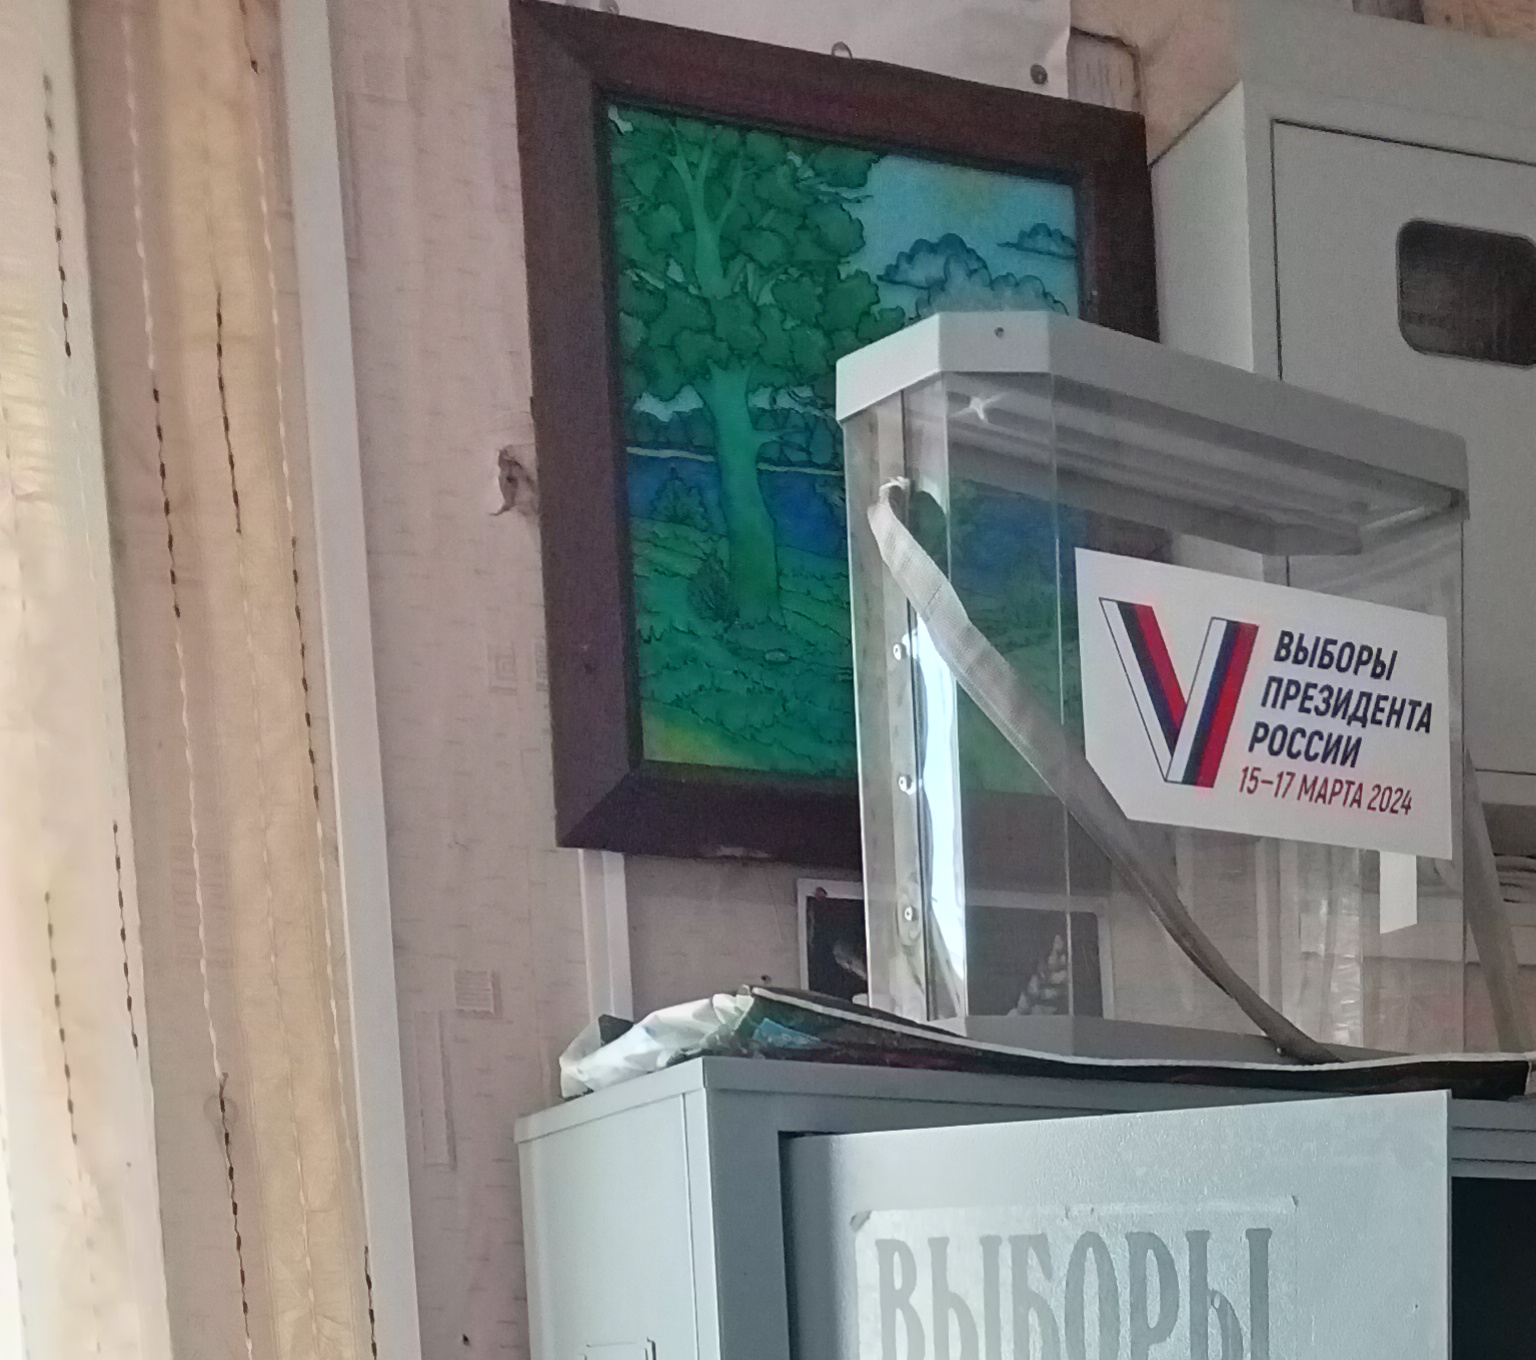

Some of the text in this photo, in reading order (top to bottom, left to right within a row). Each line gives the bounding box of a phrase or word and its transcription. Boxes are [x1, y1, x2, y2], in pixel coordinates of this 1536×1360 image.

[1274, 630, 1398, 680] ВЫБОРЫ
[1261, 675, 1433, 733] ПРЕЗИДЕНТА
[1248, 722, 1362, 768] РОССИИ
[1298, 774, 1362, 810] МАРТА
[1367, 785, 1412, 815] 2024
